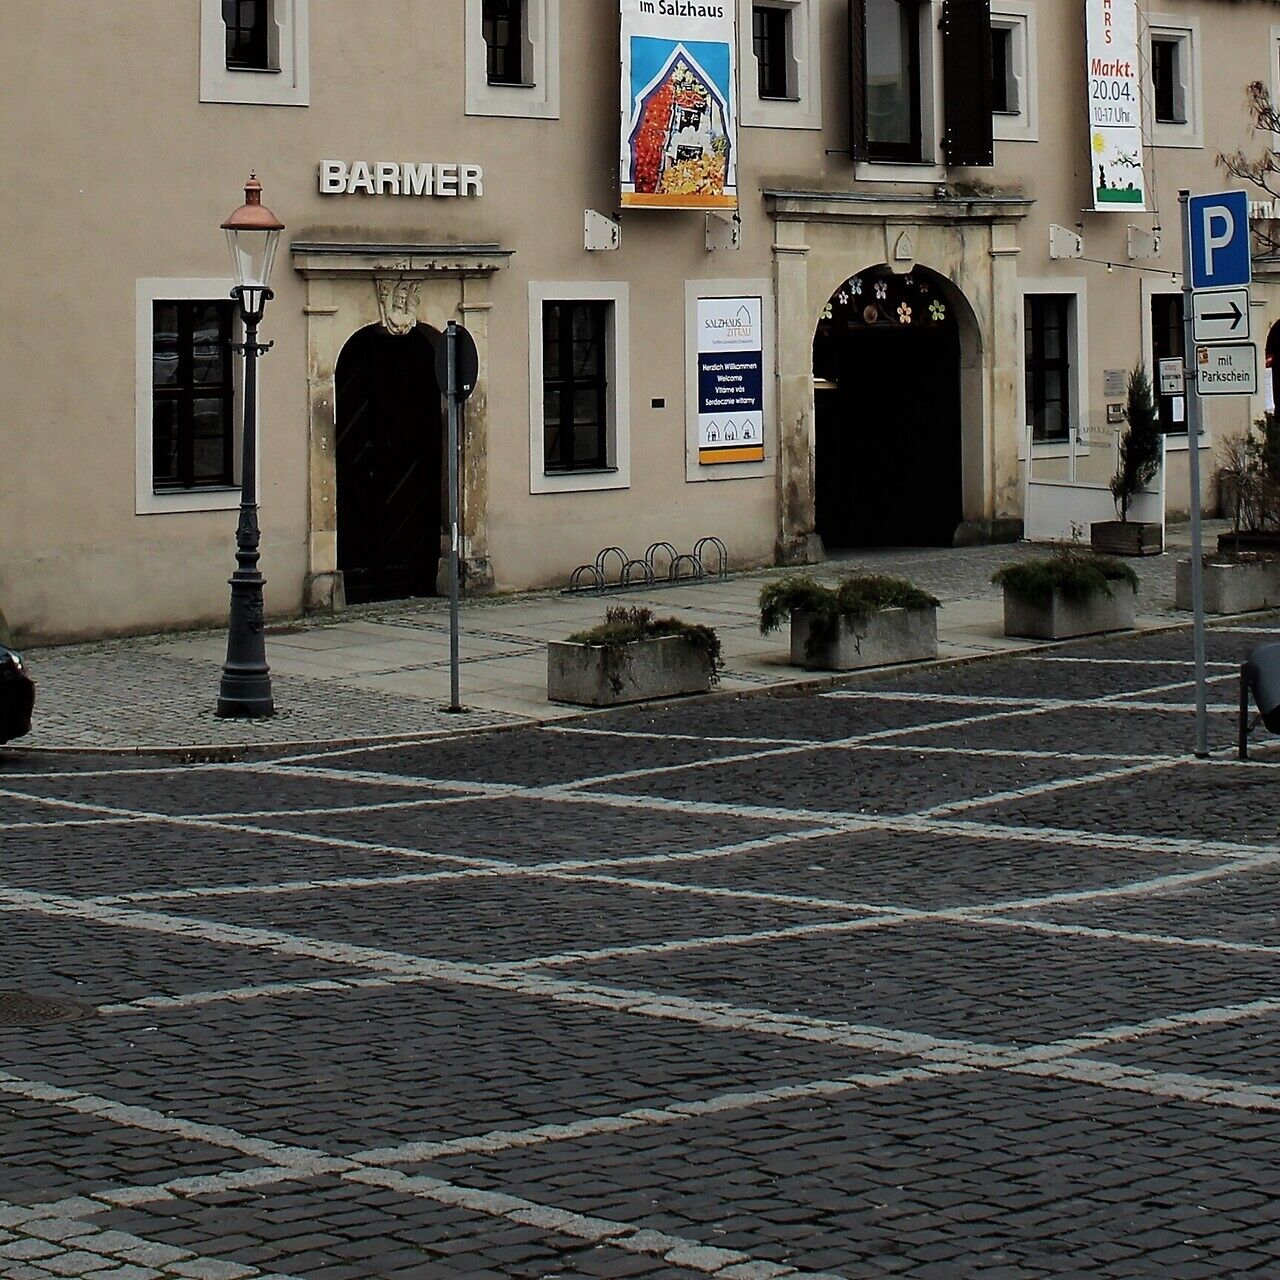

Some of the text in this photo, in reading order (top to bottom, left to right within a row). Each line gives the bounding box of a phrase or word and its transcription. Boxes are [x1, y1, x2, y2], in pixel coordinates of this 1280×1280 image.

[658, 0, 724, 19] Salzhaus
[1091, 58, 1135, 78] Markt.
[1092, 79, 1136, 103] 20.04.
[1094, 106, 1131, 123] 10-17 Uhr
[320, 159, 484, 197] BARMER
[1202, 205, 1235, 277] P
[704, 319, 742, 329] SALZHAUS
[702, 362, 758, 372] Herzlich Willkommen
[1217, 355, 1233, 367] mit
[1201, 368, 1251, 383] Parkschein
